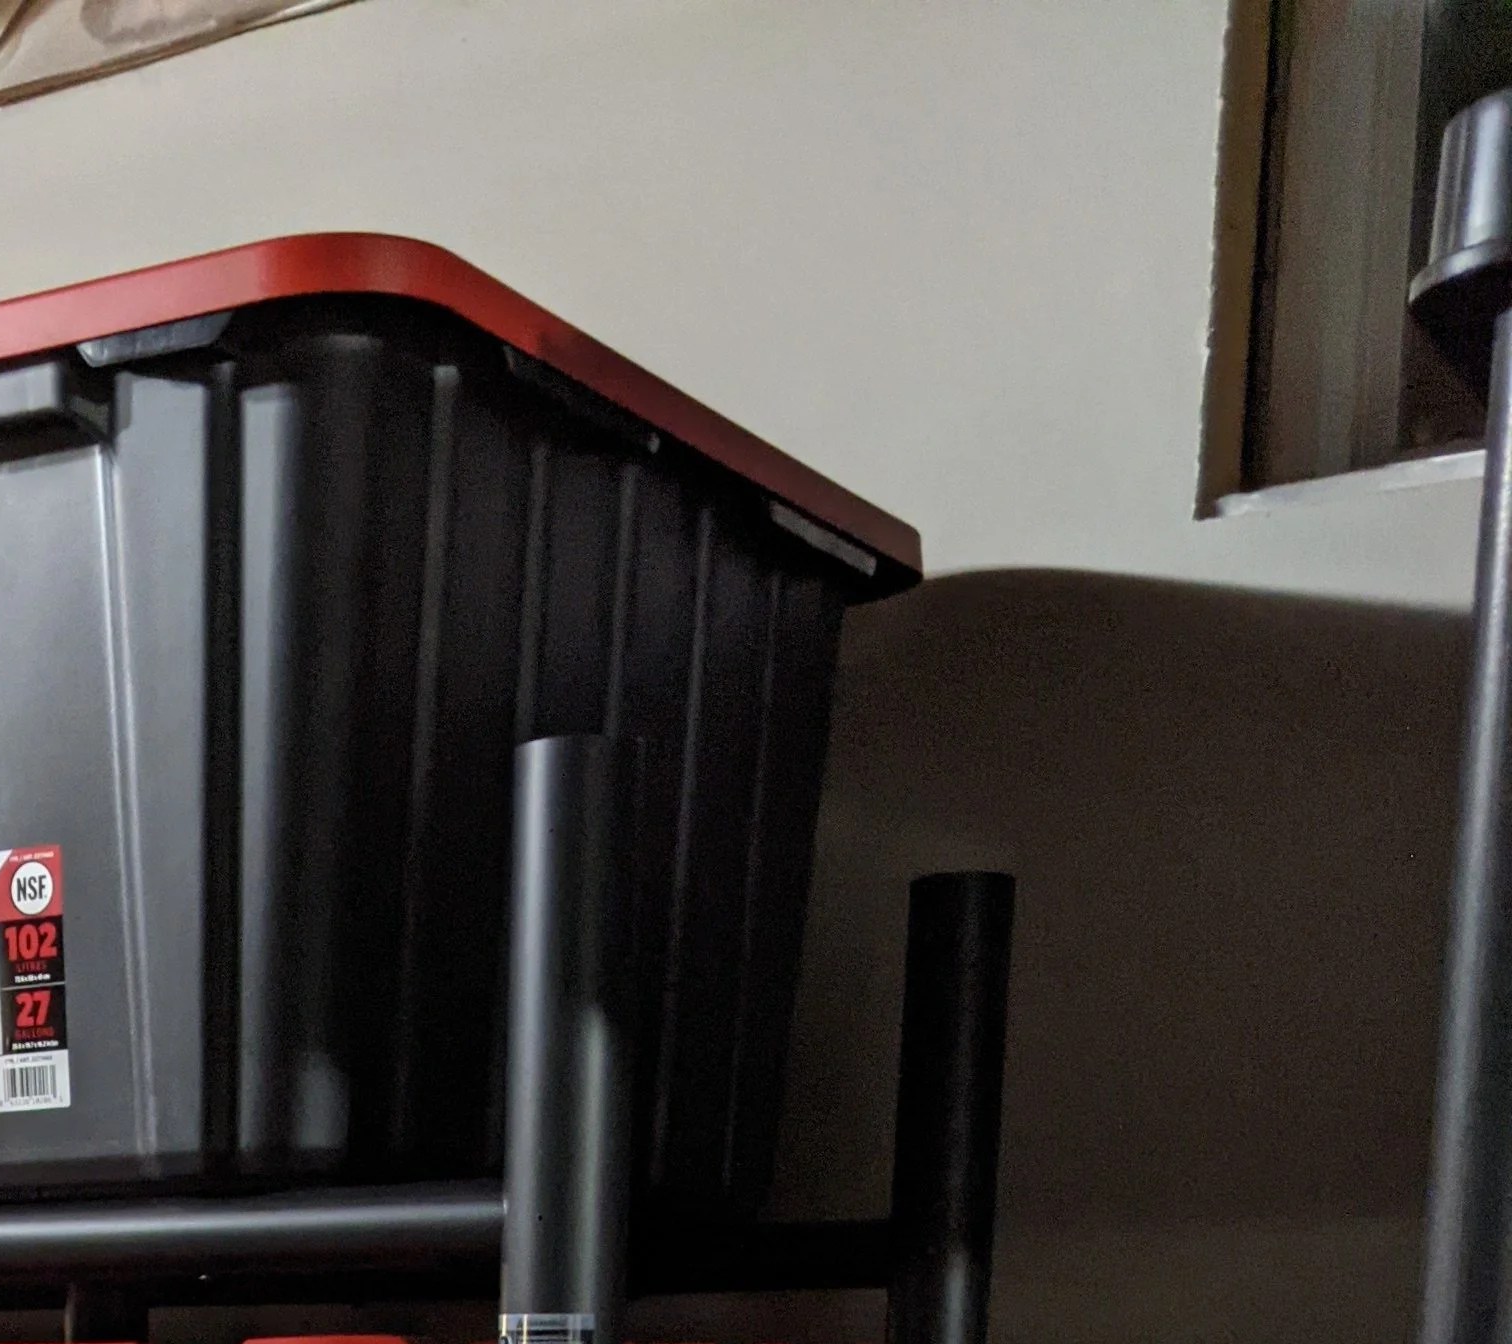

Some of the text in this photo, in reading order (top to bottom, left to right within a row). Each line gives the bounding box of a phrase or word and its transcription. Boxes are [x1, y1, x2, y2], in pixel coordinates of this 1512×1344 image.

[16, 875, 47, 901] NSF
[4, 922, 58, 961] 102
[15, 990, 51, 1027] 27
